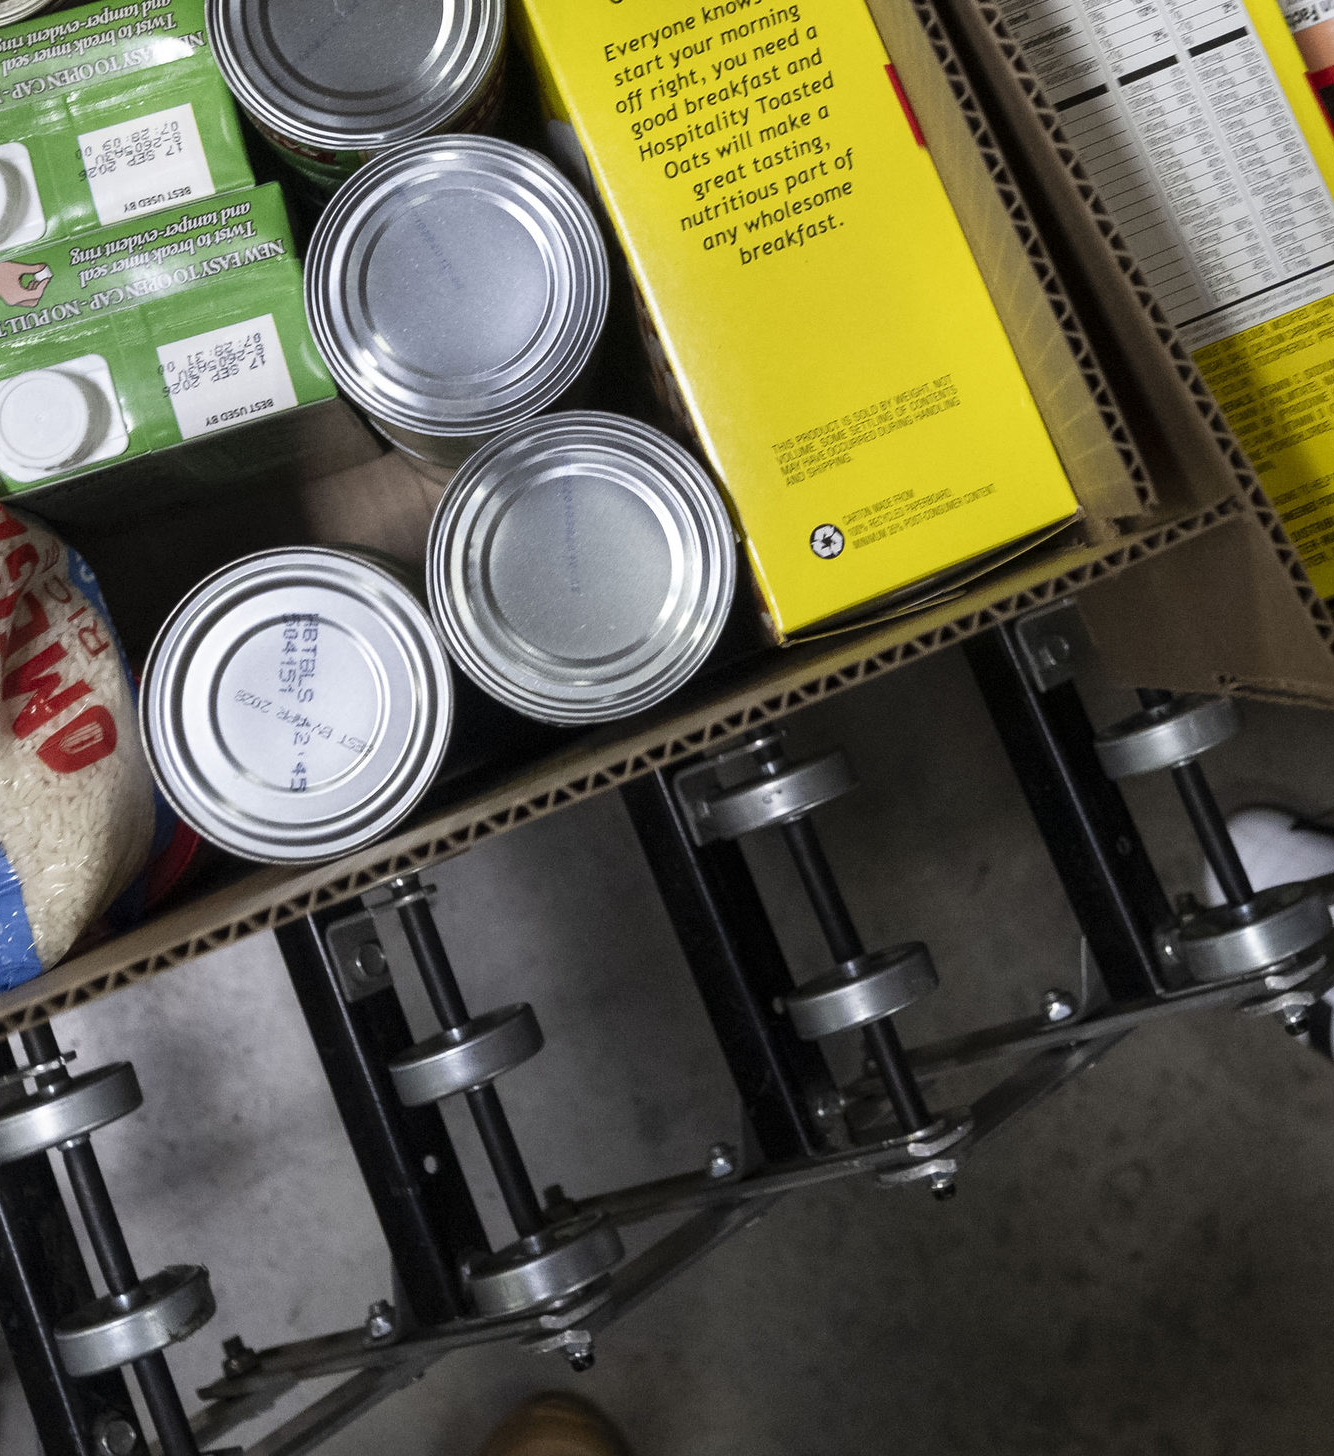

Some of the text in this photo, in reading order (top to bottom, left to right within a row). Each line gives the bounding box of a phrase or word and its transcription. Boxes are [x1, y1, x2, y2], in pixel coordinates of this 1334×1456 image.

[1284, 2, 1320, 31] Fact
[0, 10, 177, 77] Twist to break inner seal
[601, 12, 699, 66] Everyone
[610, 0, 801, 88] start your morning
[43, 61, 96, 89] OPEN
[92, 54, 118, 75] TO
[611, 24, 818, 118] off right, you need a
[10, 75, 46, 99] CAP
[627, 46, 824, 141] good breakfast and
[636, 69, 836, 166] Hospitality Toasted
[78, 141, 184, 181] 17 SEP 2026
[661, 103, 830, 180] Oats will make a
[689, 128, 831, 201] great tasting,
[122, 184, 192, 213] BEST USED BY
[676, 146, 859, 234] nutritious part of
[66, 201, 253, 269] and tamper-evident ring
[700, 175, 854, 255] any wholesome
[77, 218, 257, 287] Twist to break inner seal
[238, 237, 285, 265] NEW
[736, 207, 845, 269] breakfast.
[171, 264, 196, 285] TO
[194, 250, 242, 278] EASY
[87, 286, 123, 310] CAP
[121, 271, 172, 300] OPEN
[4, 307, 50, 334] PULL
[49, 298, 81, 321] NO
[161, 354, 267, 398] 17 SEP 2026
[204, 397, 274, 426] BEST USED BY
